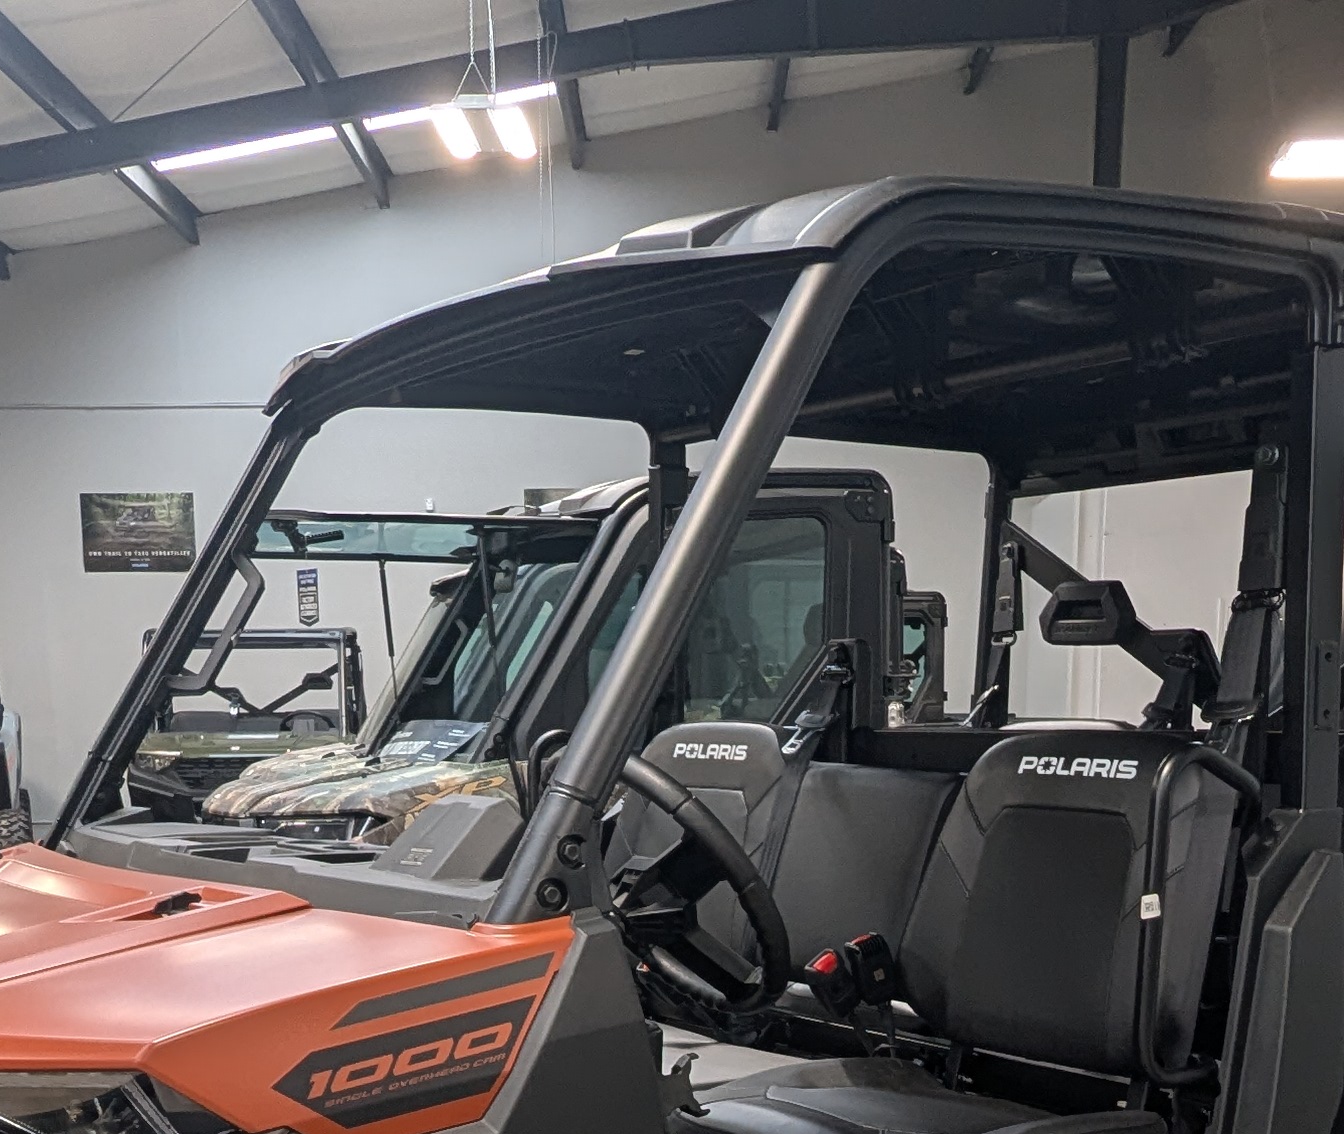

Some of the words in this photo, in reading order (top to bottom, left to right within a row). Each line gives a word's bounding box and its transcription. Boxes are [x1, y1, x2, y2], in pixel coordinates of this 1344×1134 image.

[672, 742, 748, 761] POLARIS
[1017, 755, 1139, 780] POLARIS
[306, 1021, 514, 1101] 1000
[323, 1085, 384, 1109] SINGLE
[388, 1062, 472, 1092] OVERHEAD
[472, 1052, 507, 1068] CAM
